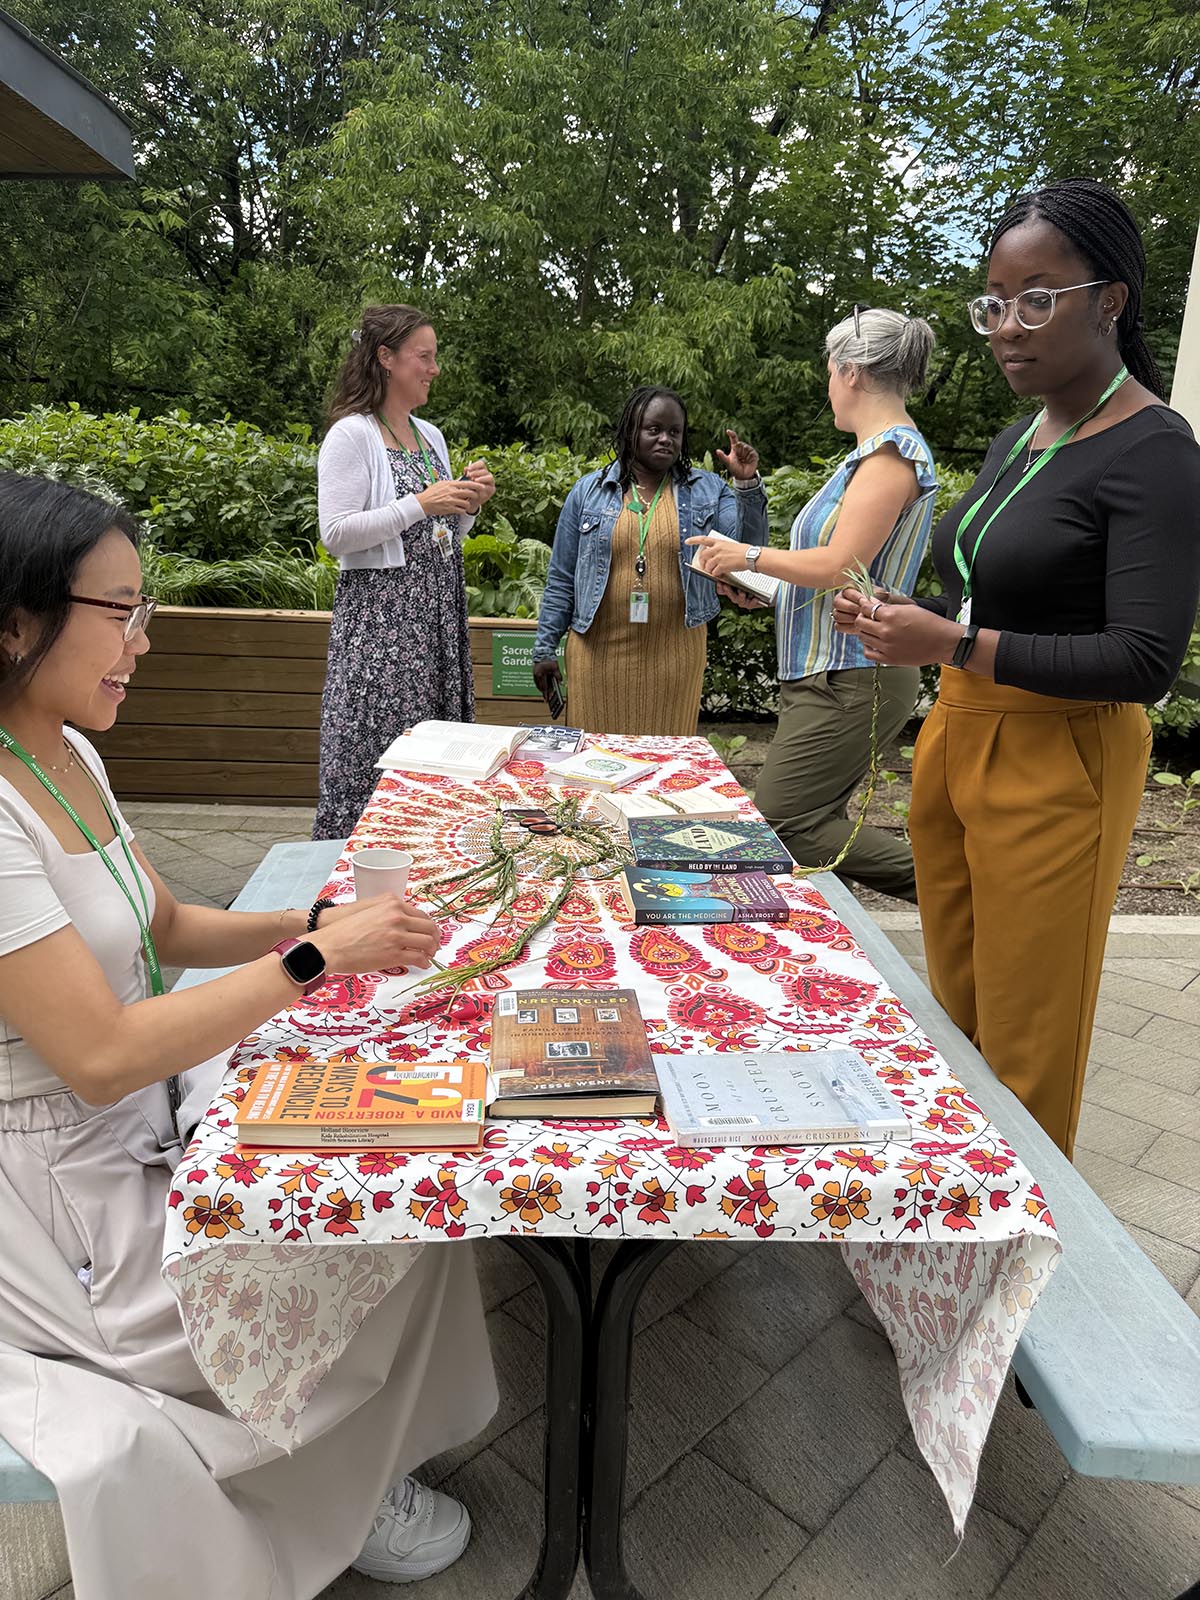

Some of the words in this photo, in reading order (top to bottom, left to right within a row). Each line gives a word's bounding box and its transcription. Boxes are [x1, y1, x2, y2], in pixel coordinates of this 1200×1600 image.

[502, 656, 533, 666] Garde
[31, 763, 58, 794] Bloorview
[58, 795, 80, 821] Holland
[280, 1065, 327, 1119] RECONCILE
[325, 1065, 359, 1092] WAYS
[357, 1065, 463, 1107] 52
[691, 1072, 721, 1112] MOON
[744, 1059, 789, 1122] CRUSTED
[789, 1069, 824, 1107] SNOW
[315, 1110, 404, 1120] ROBERTSON
[319, 1096, 350, 1108] TO
[431, 1110, 462, 1118] AVID
[751, 1134, 780, 1142] MOON
[805, 1132, 850, 1140] CRUSTED
[853, 1131, 870, 1139] SN
